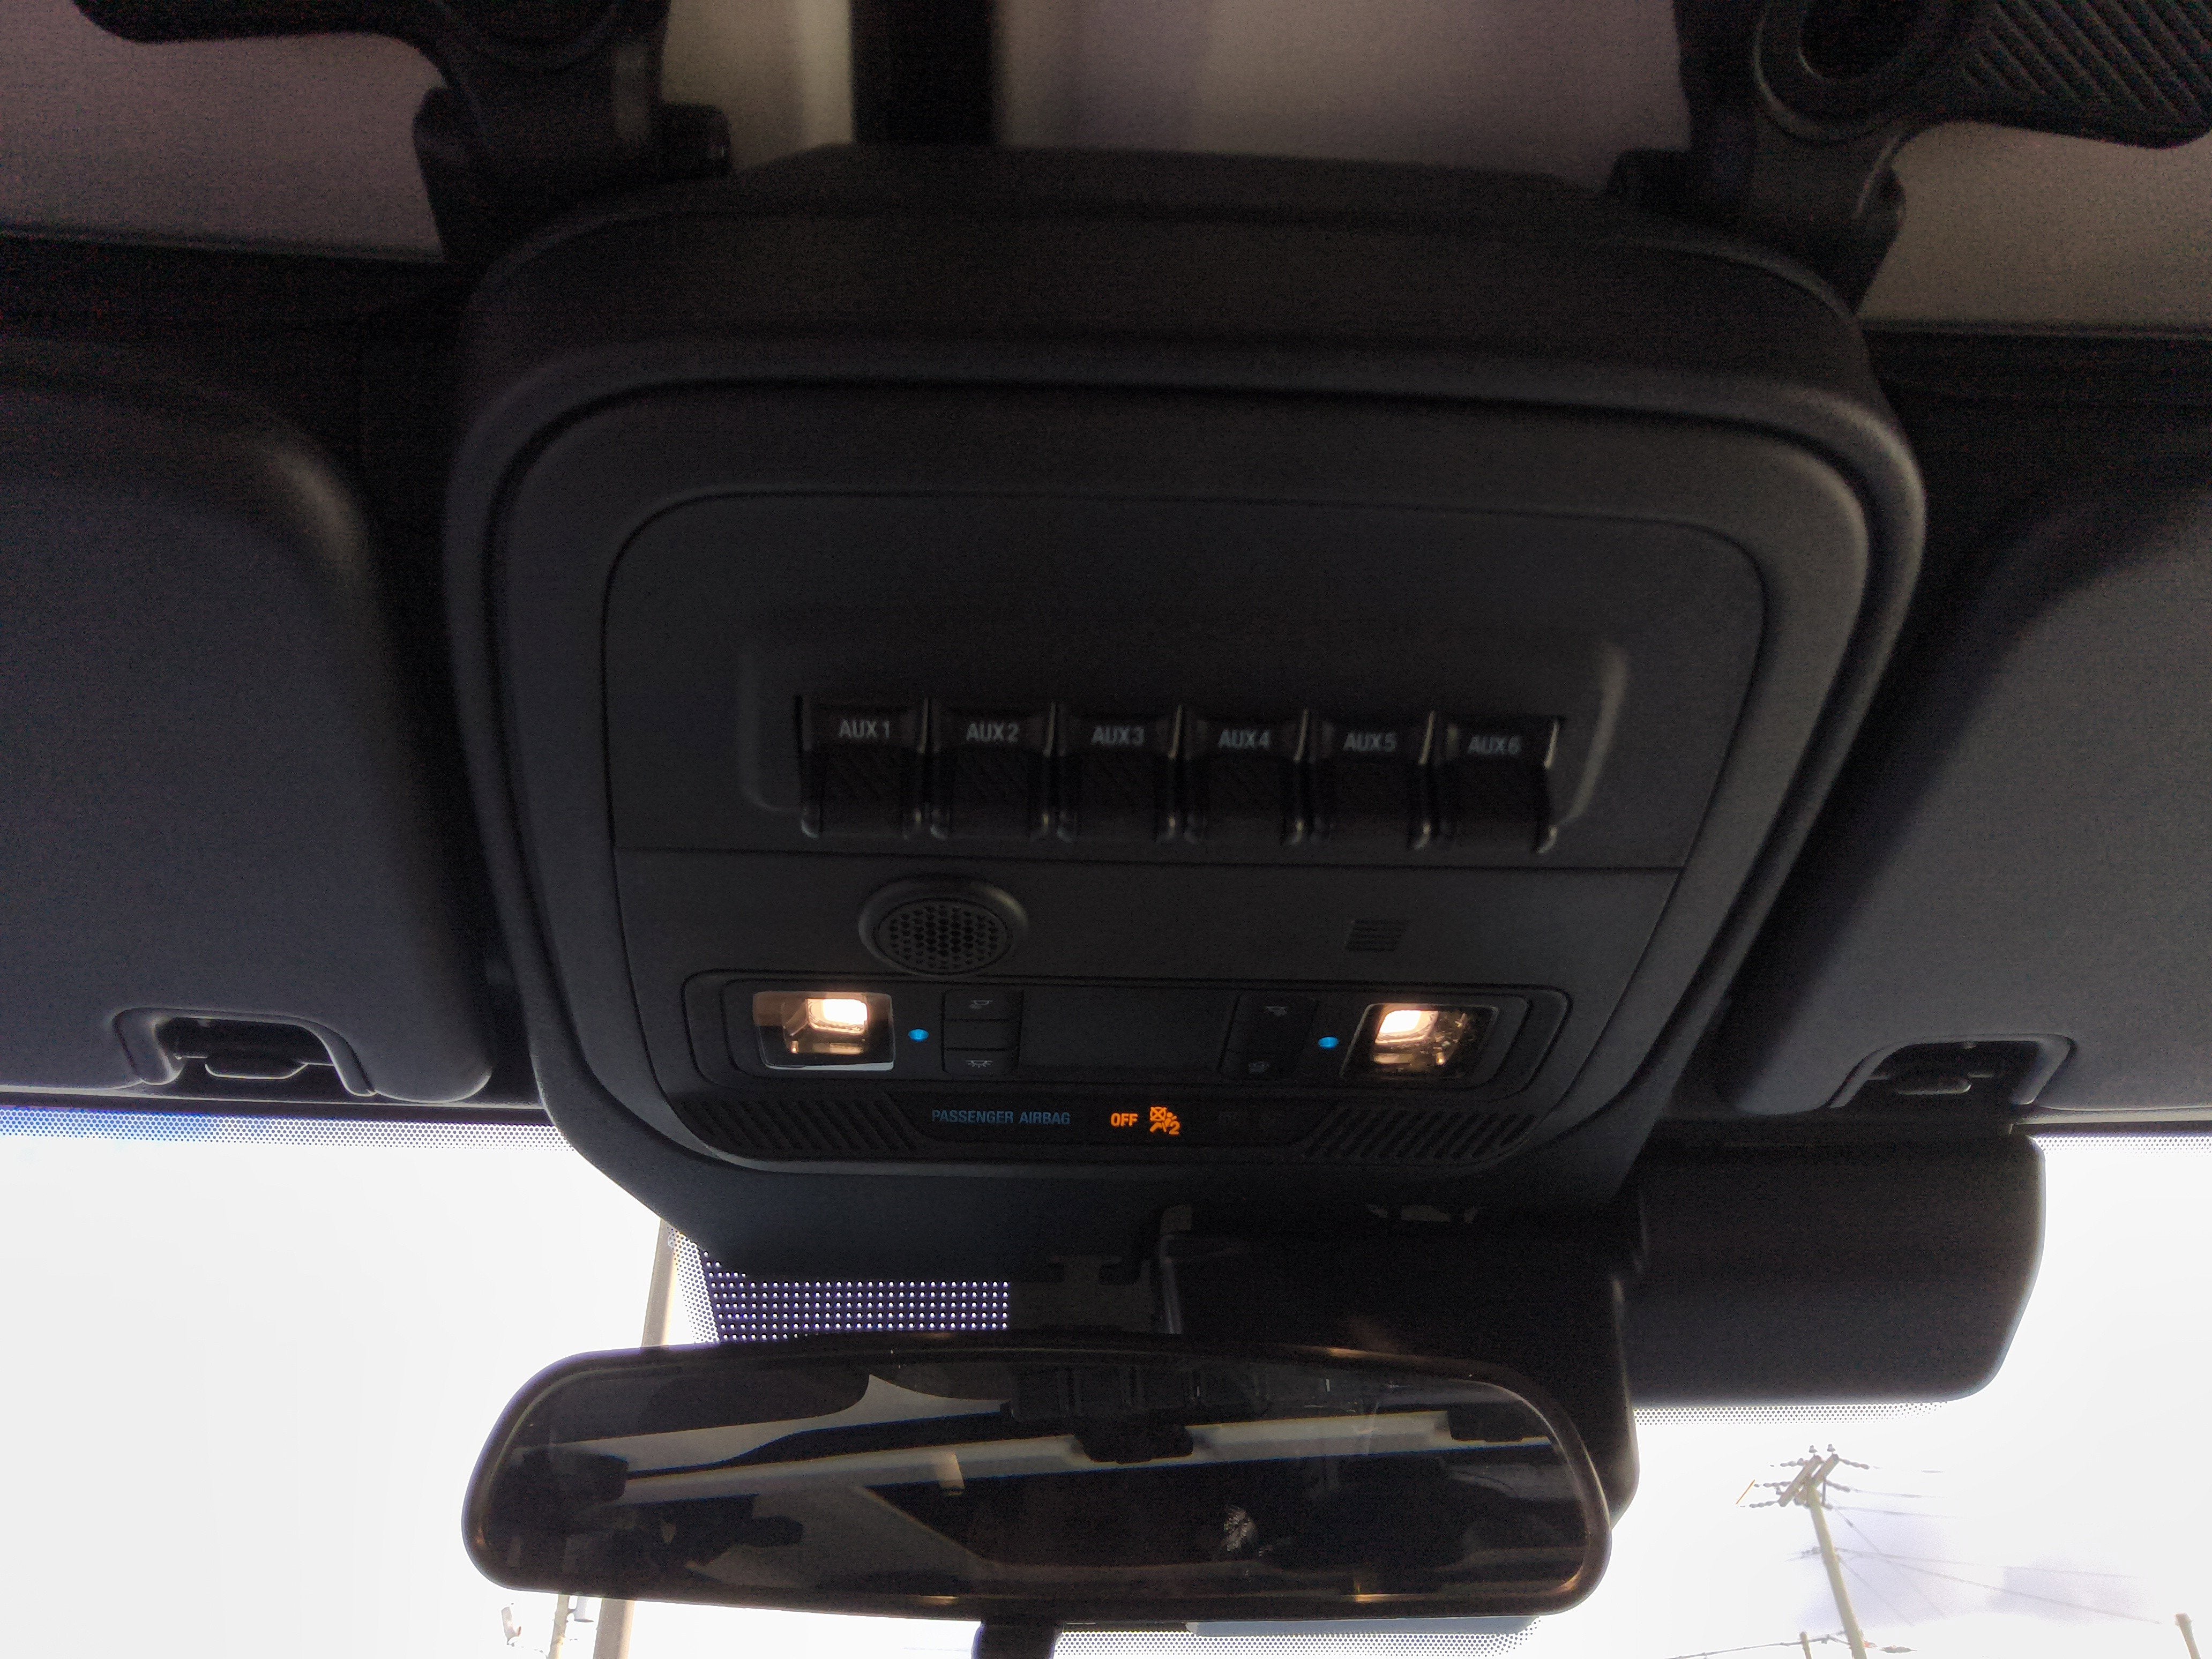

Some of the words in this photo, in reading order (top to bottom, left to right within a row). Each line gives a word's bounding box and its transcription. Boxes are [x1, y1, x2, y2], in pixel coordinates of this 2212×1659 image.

[931, 1109, 1013, 1124] PASSENGER
[1019, 1111, 1070, 1125] AIRBAG
[1110, 1113, 1138, 1127] OFF
